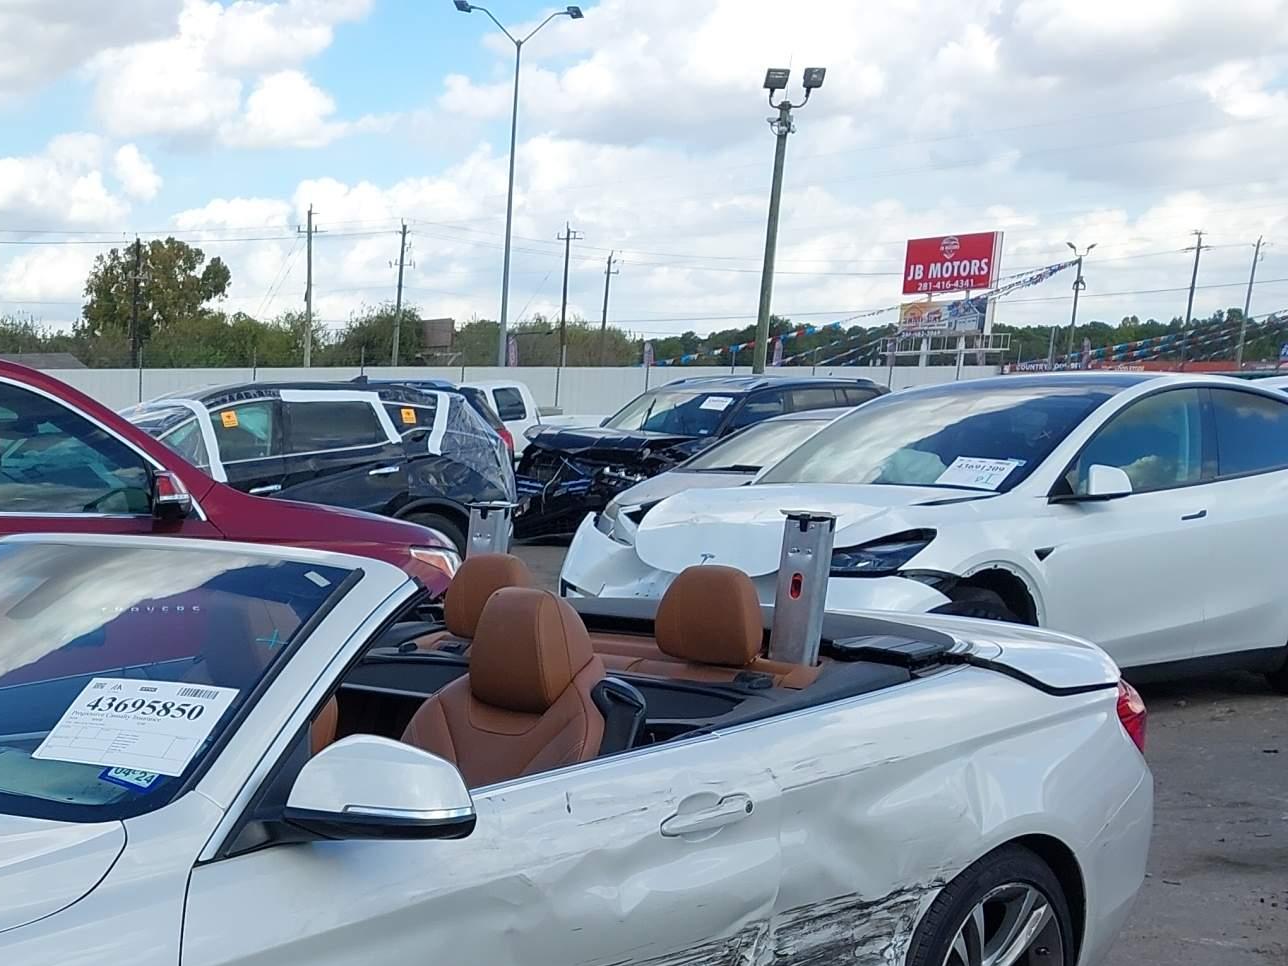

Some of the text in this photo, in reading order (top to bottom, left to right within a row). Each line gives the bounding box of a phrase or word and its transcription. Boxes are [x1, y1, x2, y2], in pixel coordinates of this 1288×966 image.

[907, 258, 989, 281] JB MOTORS
[917, 279, 974, 291] 281-416-4341
[86, 695, 205, 721] 43695850
